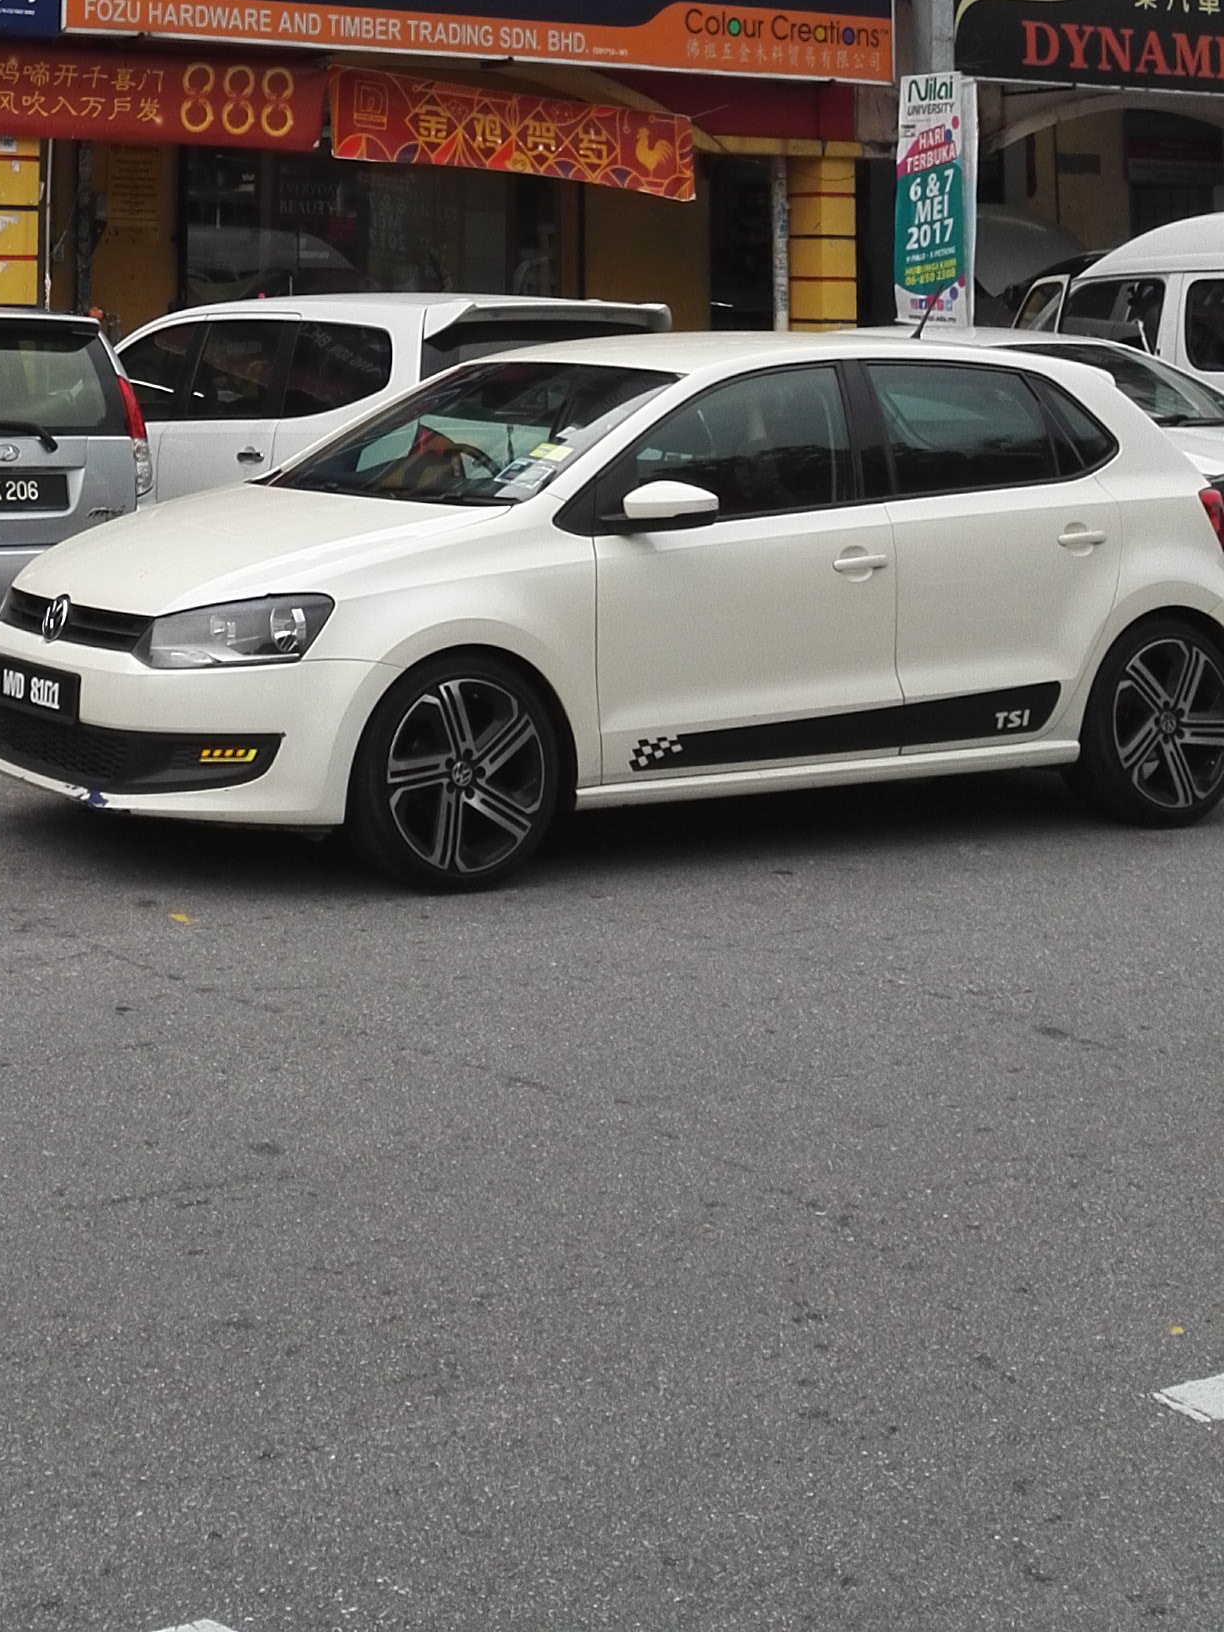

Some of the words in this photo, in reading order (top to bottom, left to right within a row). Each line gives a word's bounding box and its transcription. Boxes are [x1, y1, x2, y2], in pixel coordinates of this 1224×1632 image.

[148, 0, 272, 35] HARDWARE
[278, 10, 322, 37] AND
[328, 12, 402, 43] TIMBER
[408, 18, 493, 50] TRADING
[498, 25, 542, 53] SDN.
[547, 28, 589, 55] BHD.
[684, 8, 764, 39] Colour
[908, 76, 953, 103] Nilai
[907, 103, 955, 116] UNIVERSITY
[919, 126, 946, 150] HARI
[906, 142, 957, 173] TERBUKA
[910, 177, 922, 202] 6
[926, 173, 940, 197] &
[944, 168, 954, 193] 7
[915, 193, 949, 225] MEI
[905, 218, 954, 250] 2017
[6, 480, 39, 501] 206
[995, 709, 1030, 730] TSI
